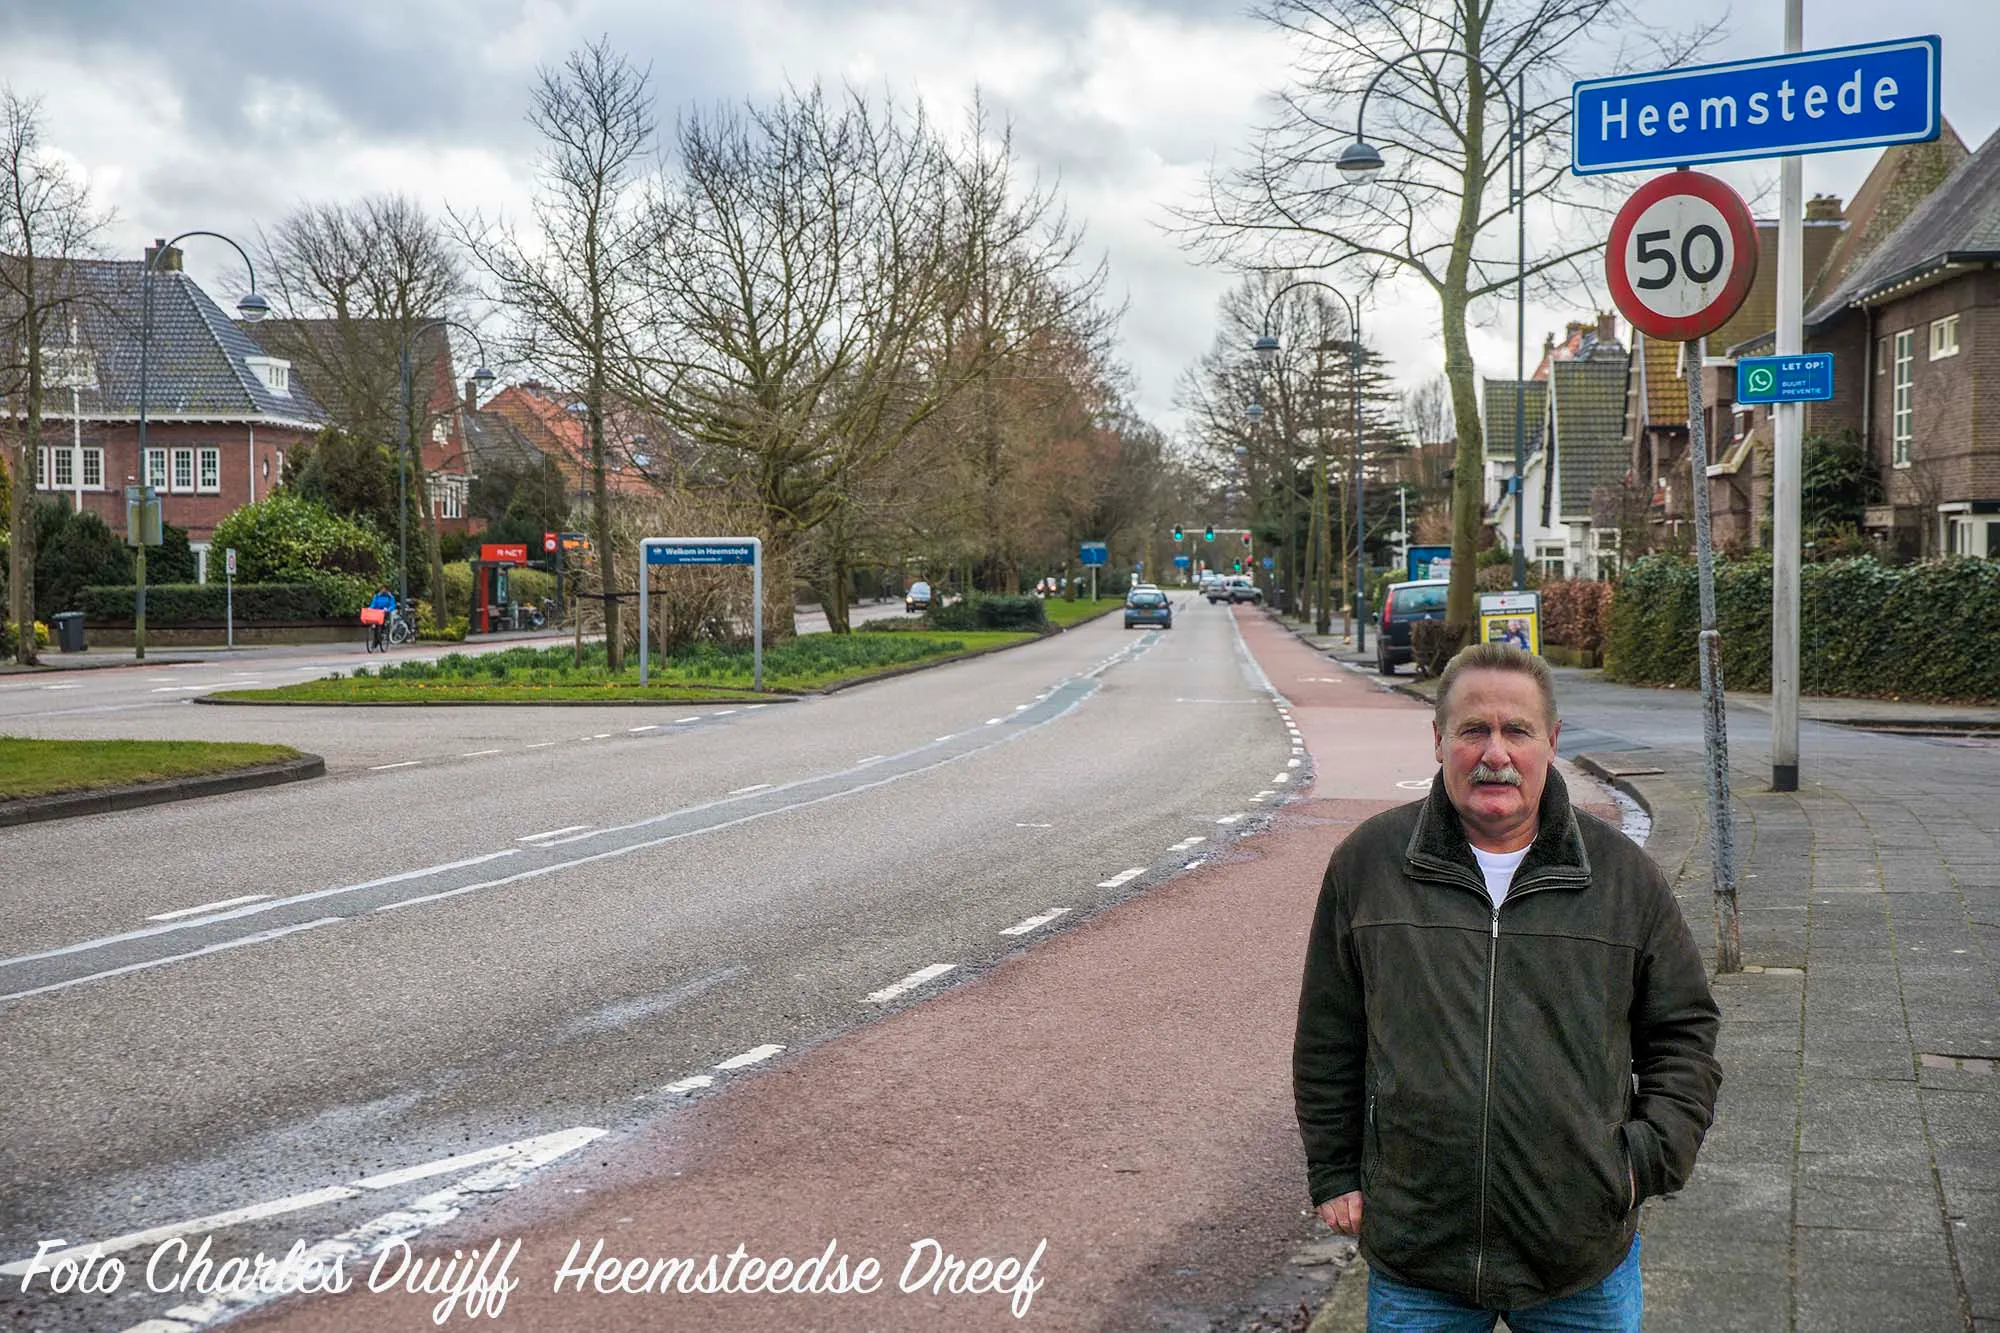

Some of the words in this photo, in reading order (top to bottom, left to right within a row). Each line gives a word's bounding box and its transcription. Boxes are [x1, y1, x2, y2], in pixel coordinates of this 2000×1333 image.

[1599, 68, 1900, 142] Heemstede
[1636, 224, 1724, 291] 50
[1782, 362, 1801, 370] LET
[1805, 361, 1824, 369] OP!
[1782, 387, 1822, 395] PREVENTIE
[665, 547, 696, 555] Welkom
[697, 547, 705, 555] in
[706, 547, 748, 555] Heemstede
